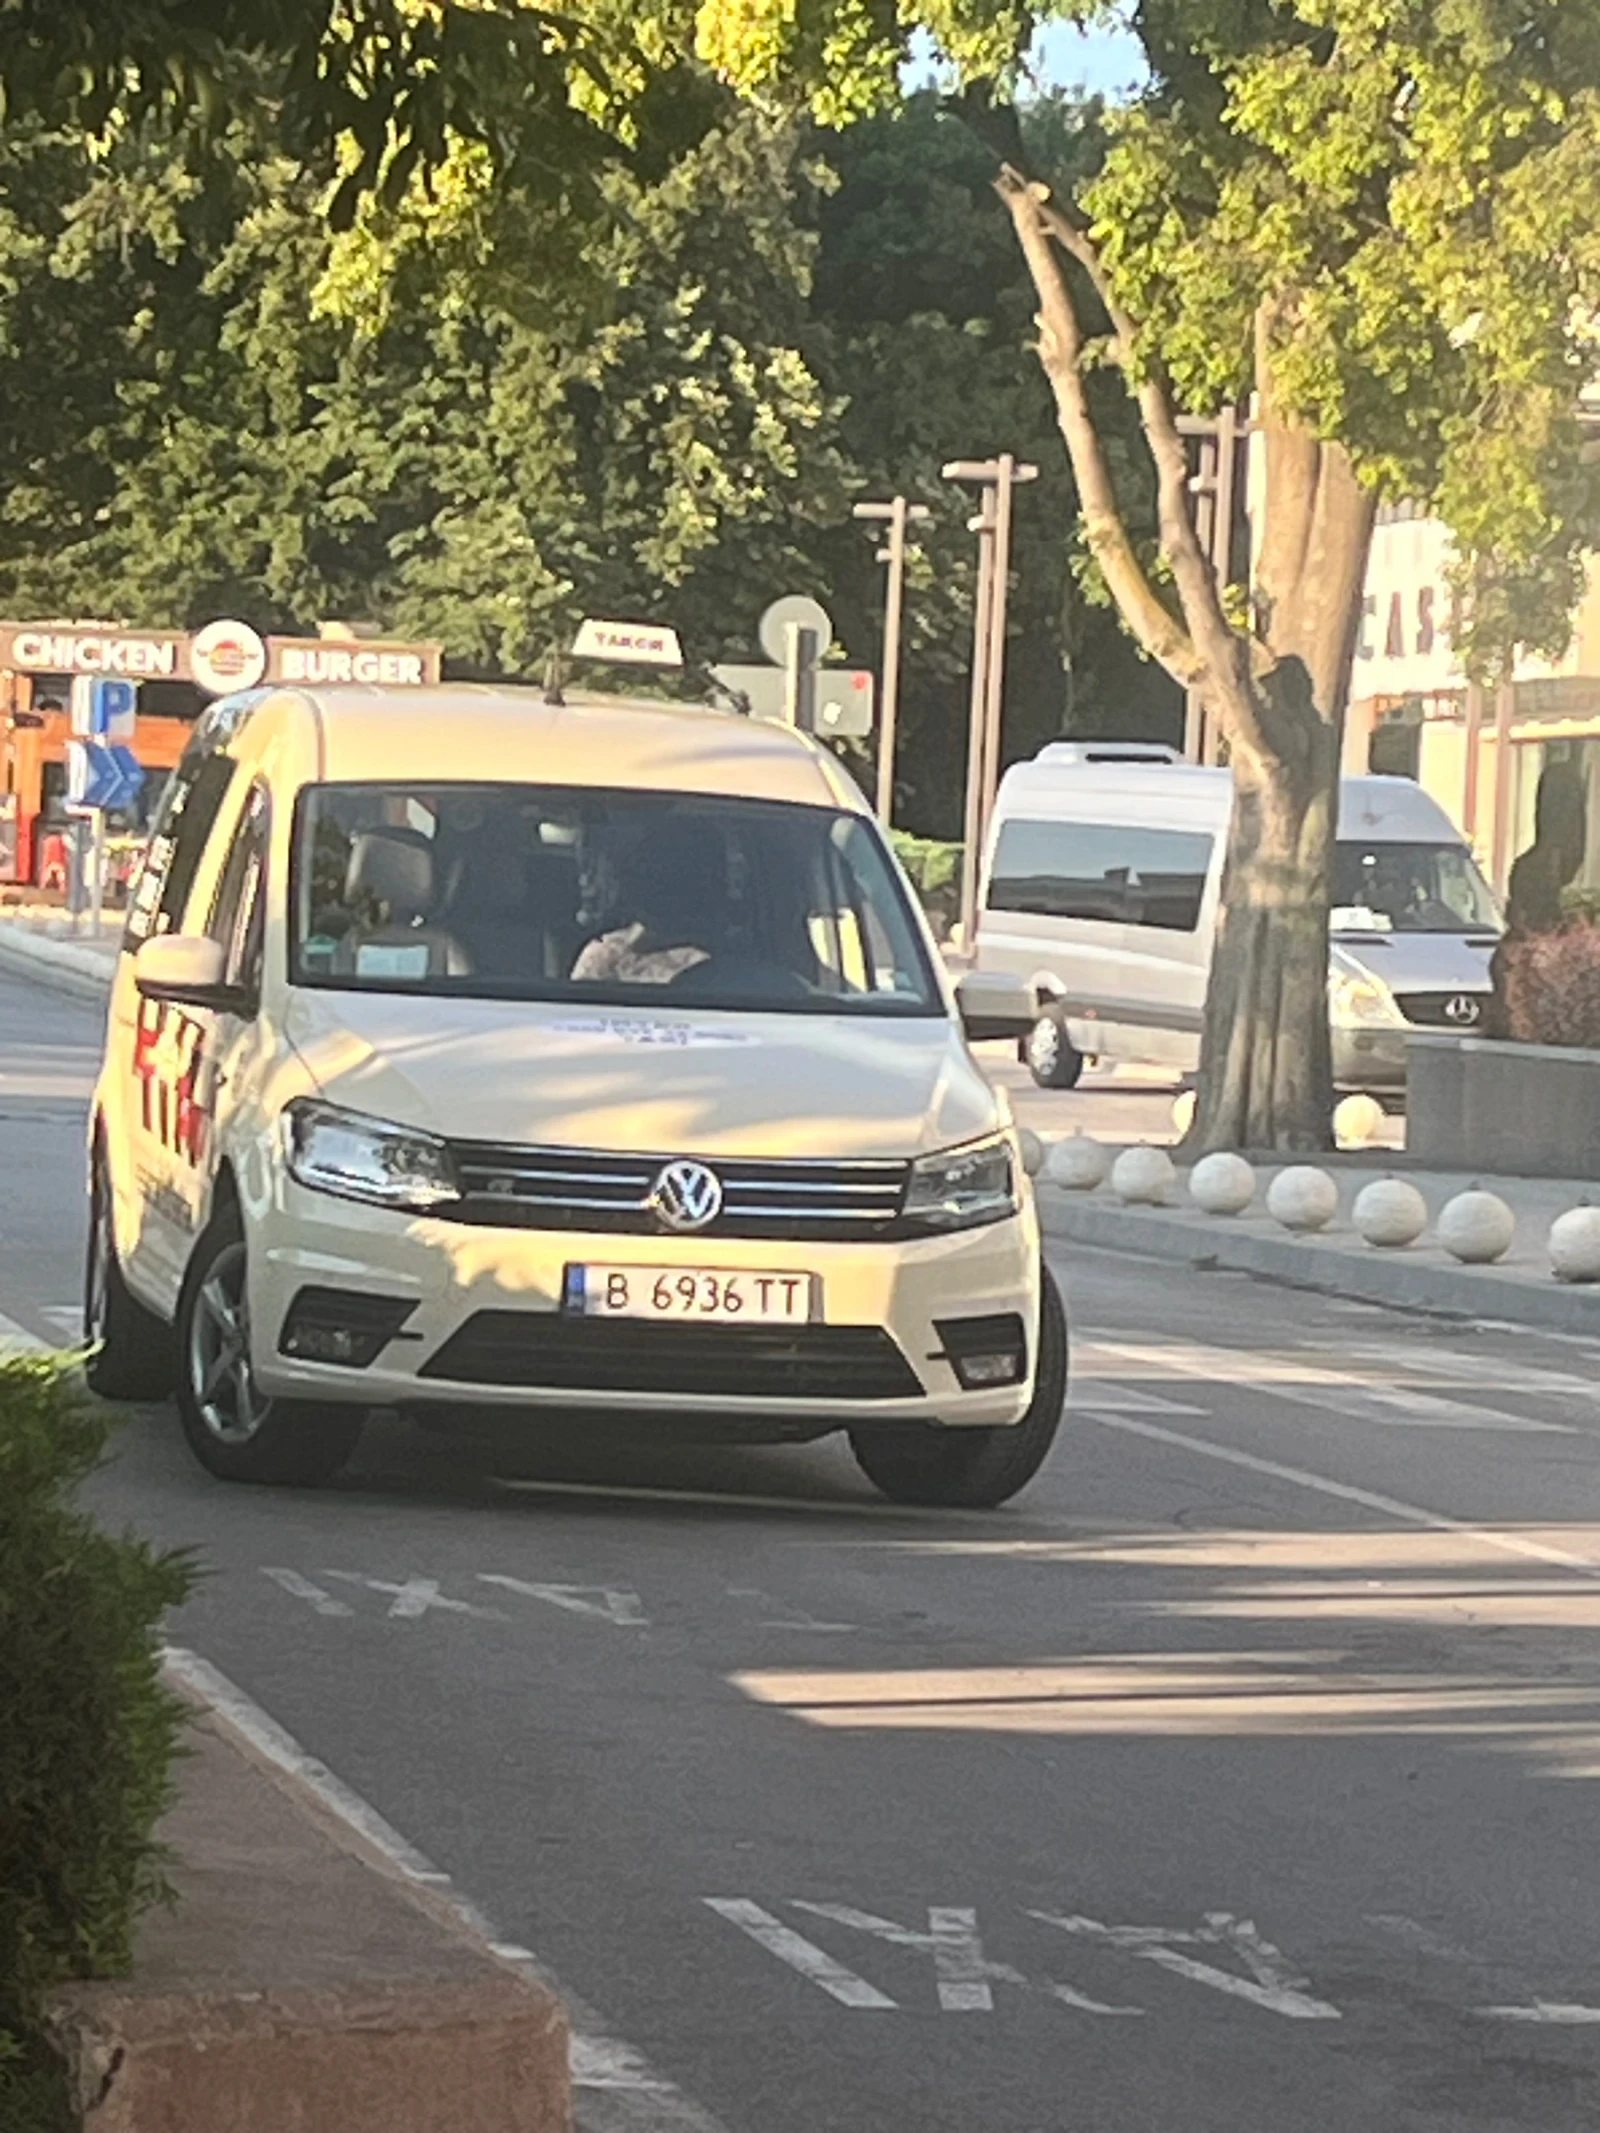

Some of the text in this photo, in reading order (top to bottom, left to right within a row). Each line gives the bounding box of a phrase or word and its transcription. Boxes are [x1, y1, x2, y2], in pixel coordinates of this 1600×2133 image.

[12, 633, 422, 684] CHICKEN BURGER
[95, 681, 132, 733] P
[606, 1273, 629, 1310] B
[652, 1274, 743, 1313] 6936
[753, 1278, 801, 1315] TT
